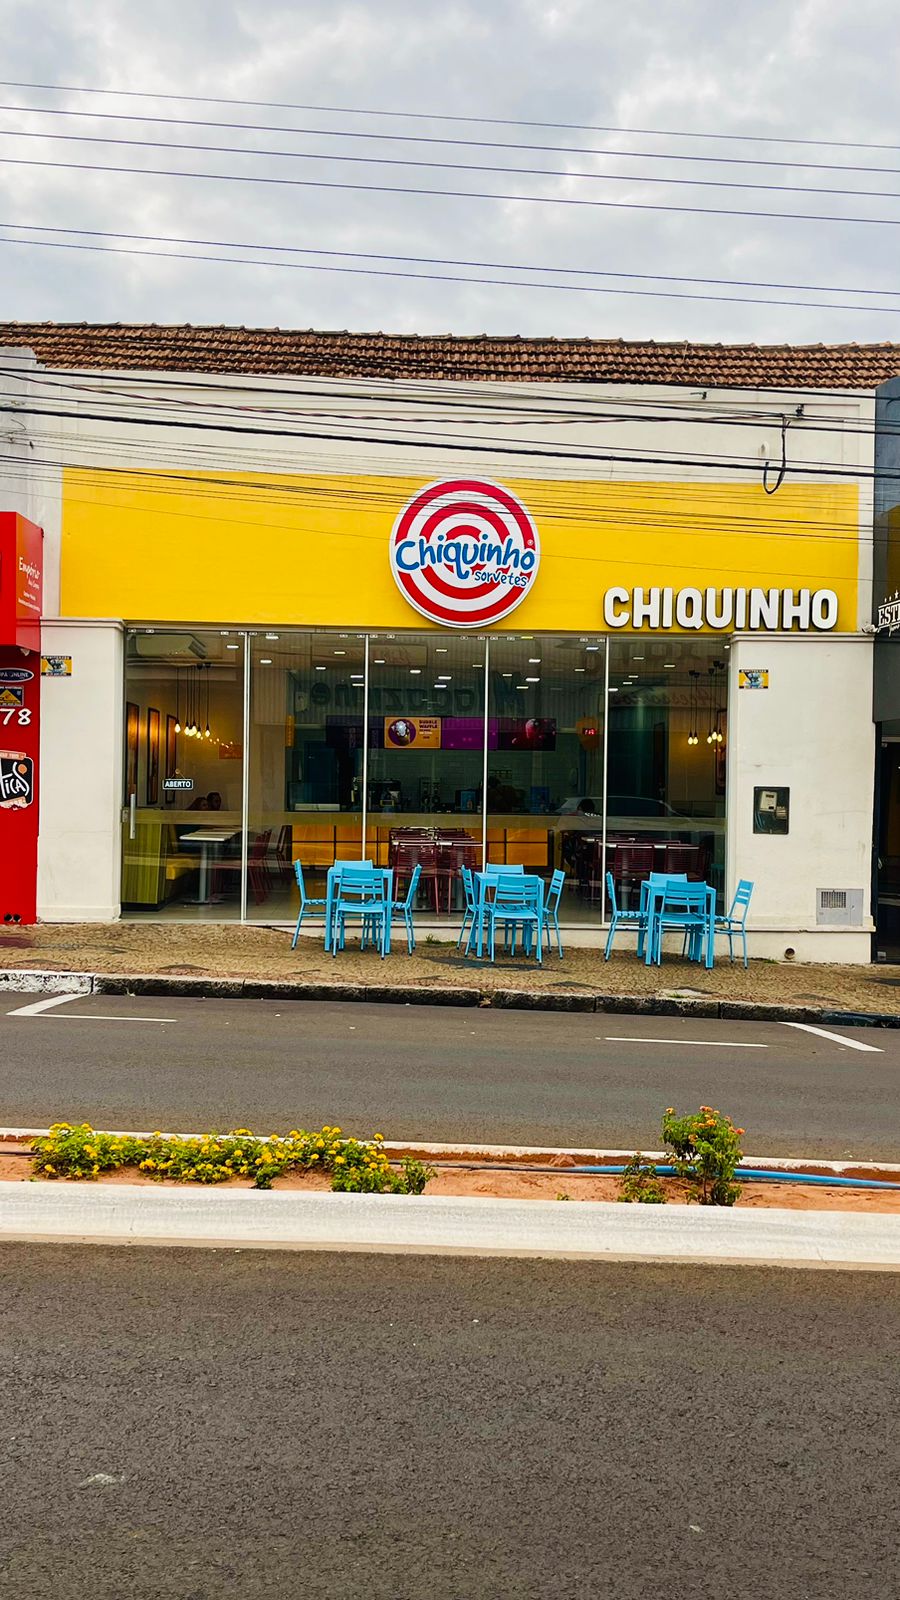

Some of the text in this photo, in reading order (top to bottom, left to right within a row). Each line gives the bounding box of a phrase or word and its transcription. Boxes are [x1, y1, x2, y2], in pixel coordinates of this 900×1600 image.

[396, 534, 535, 580] Chiquinho
[474, 570, 528, 587] sorvetes
[603, 586, 839, 631] CHIQUINHO
[165, 780, 191, 788] ABERTO
